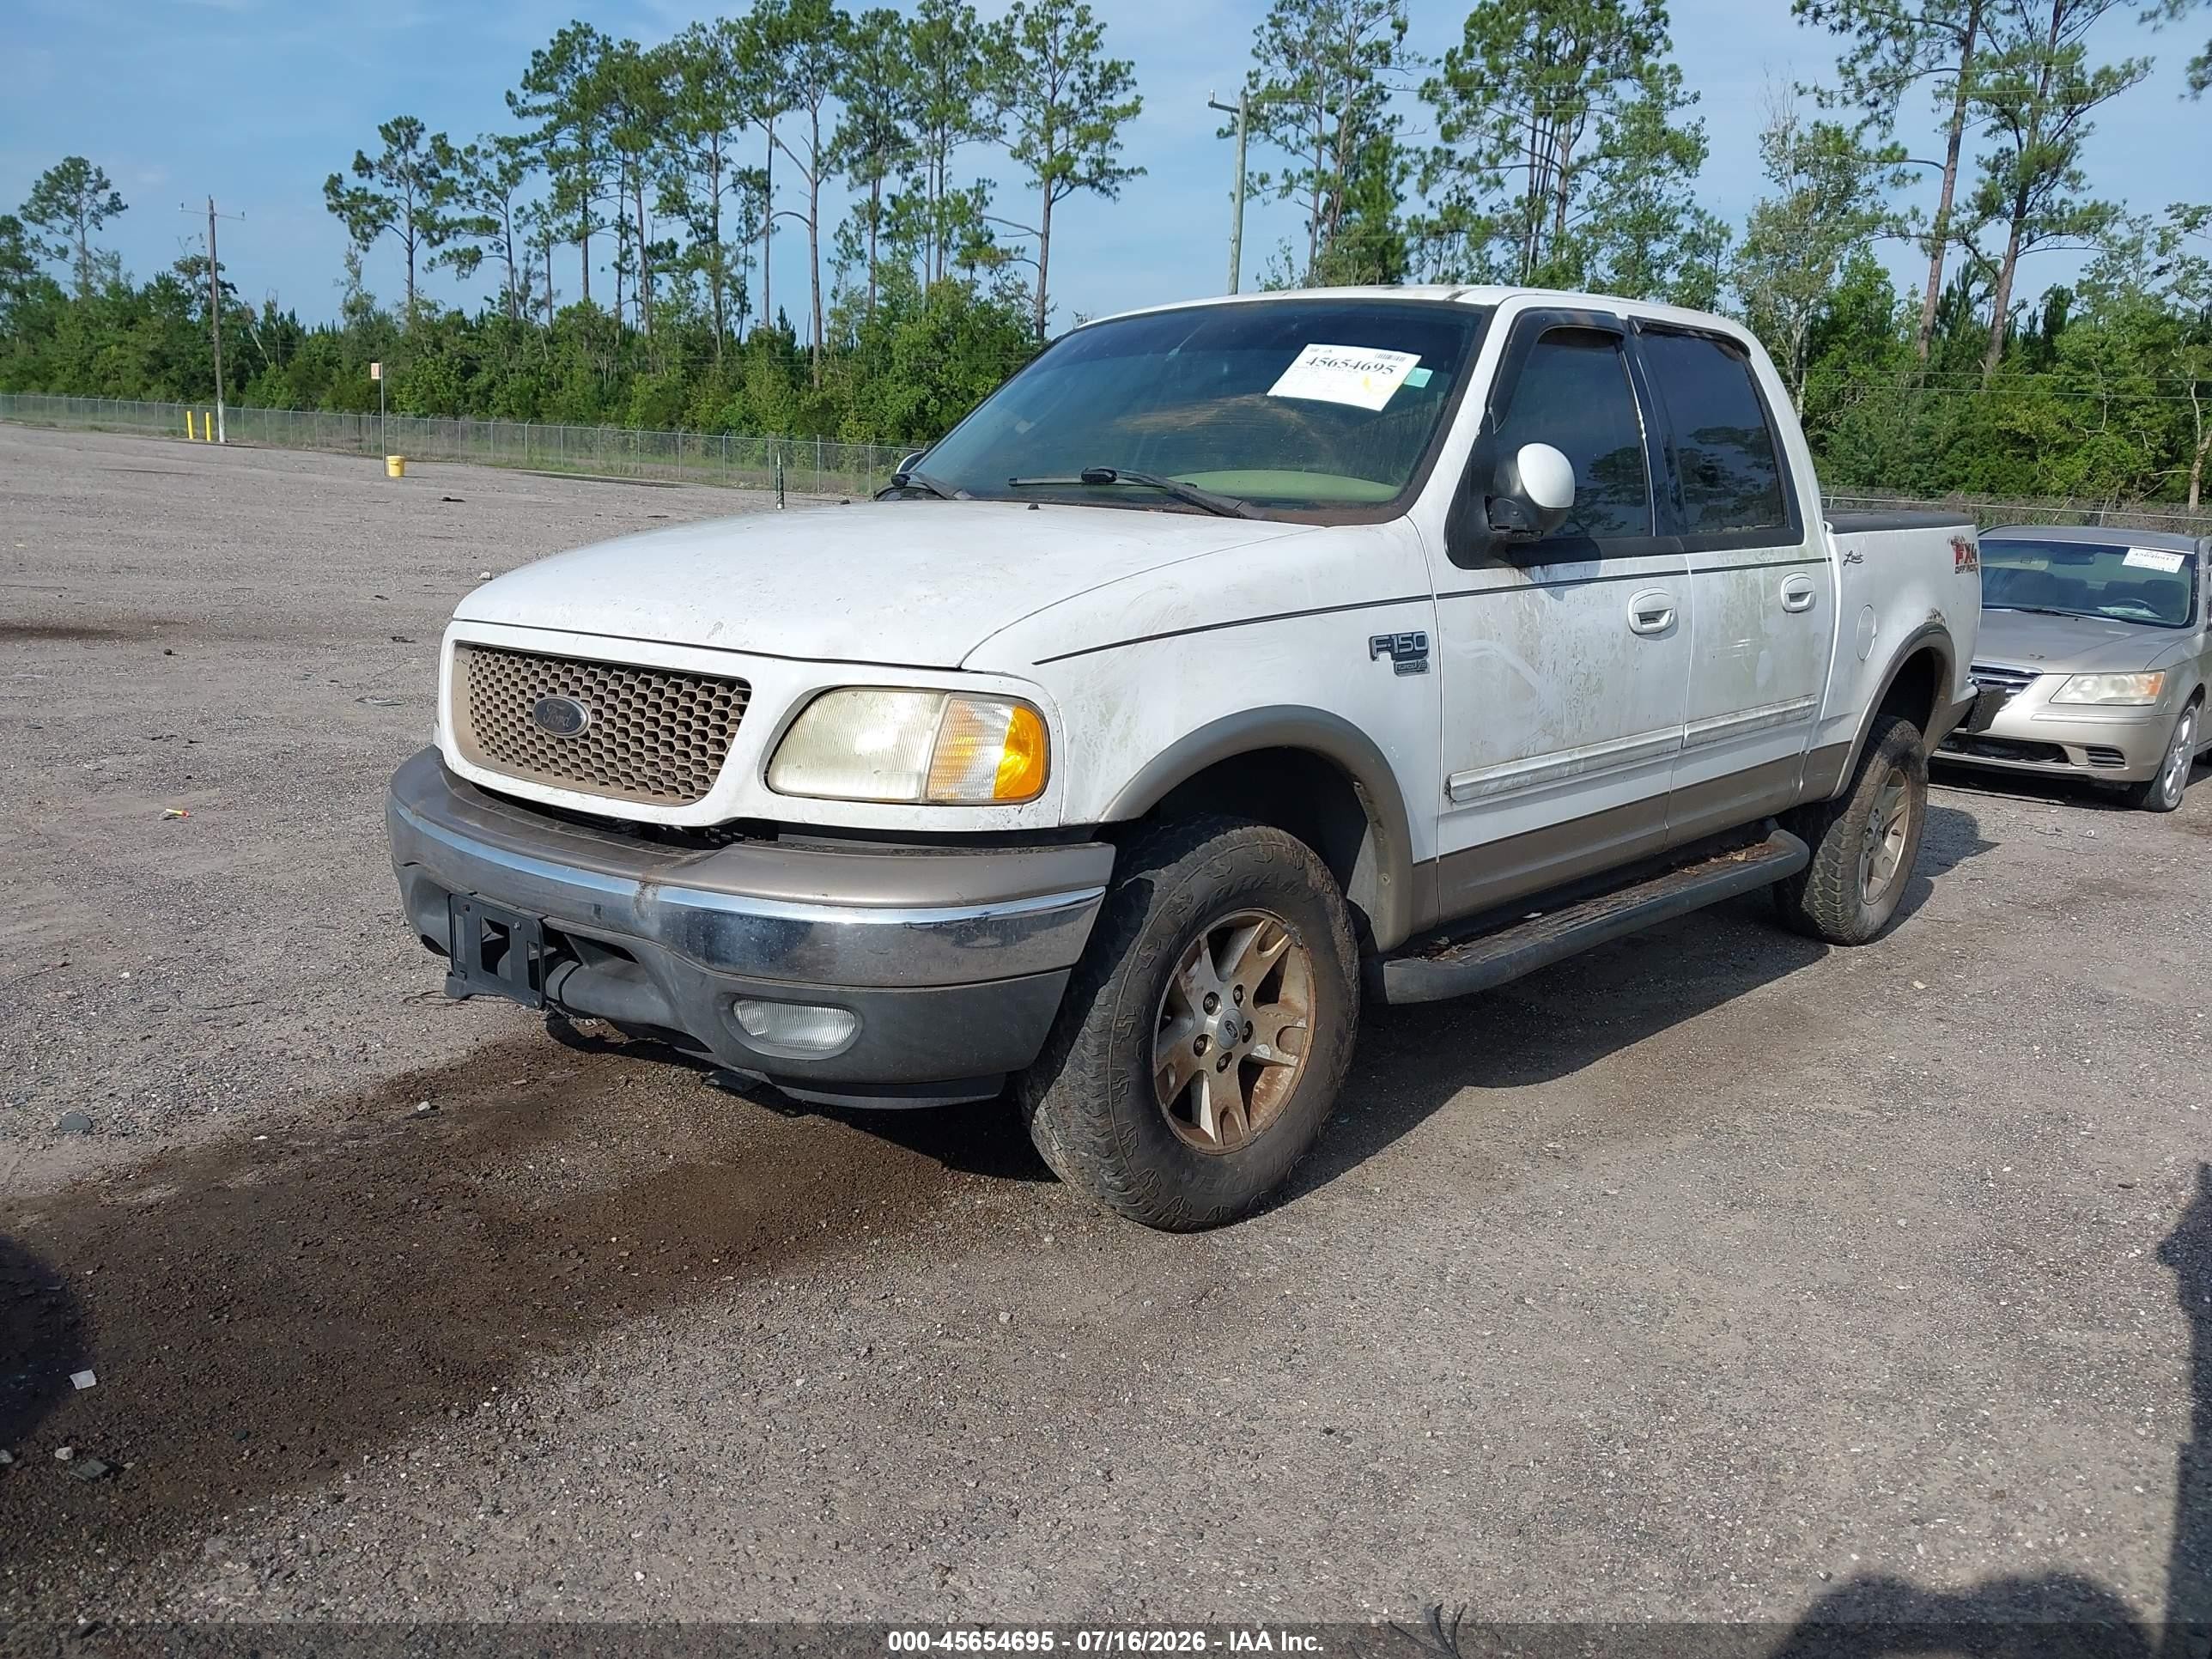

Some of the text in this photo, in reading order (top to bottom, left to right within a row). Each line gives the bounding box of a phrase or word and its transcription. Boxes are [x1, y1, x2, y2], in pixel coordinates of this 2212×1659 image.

[1305, 356, 1398, 375] 45654695
[1955, 543, 1977, 564] FX4
[544, 702, 573, 728] Ford
